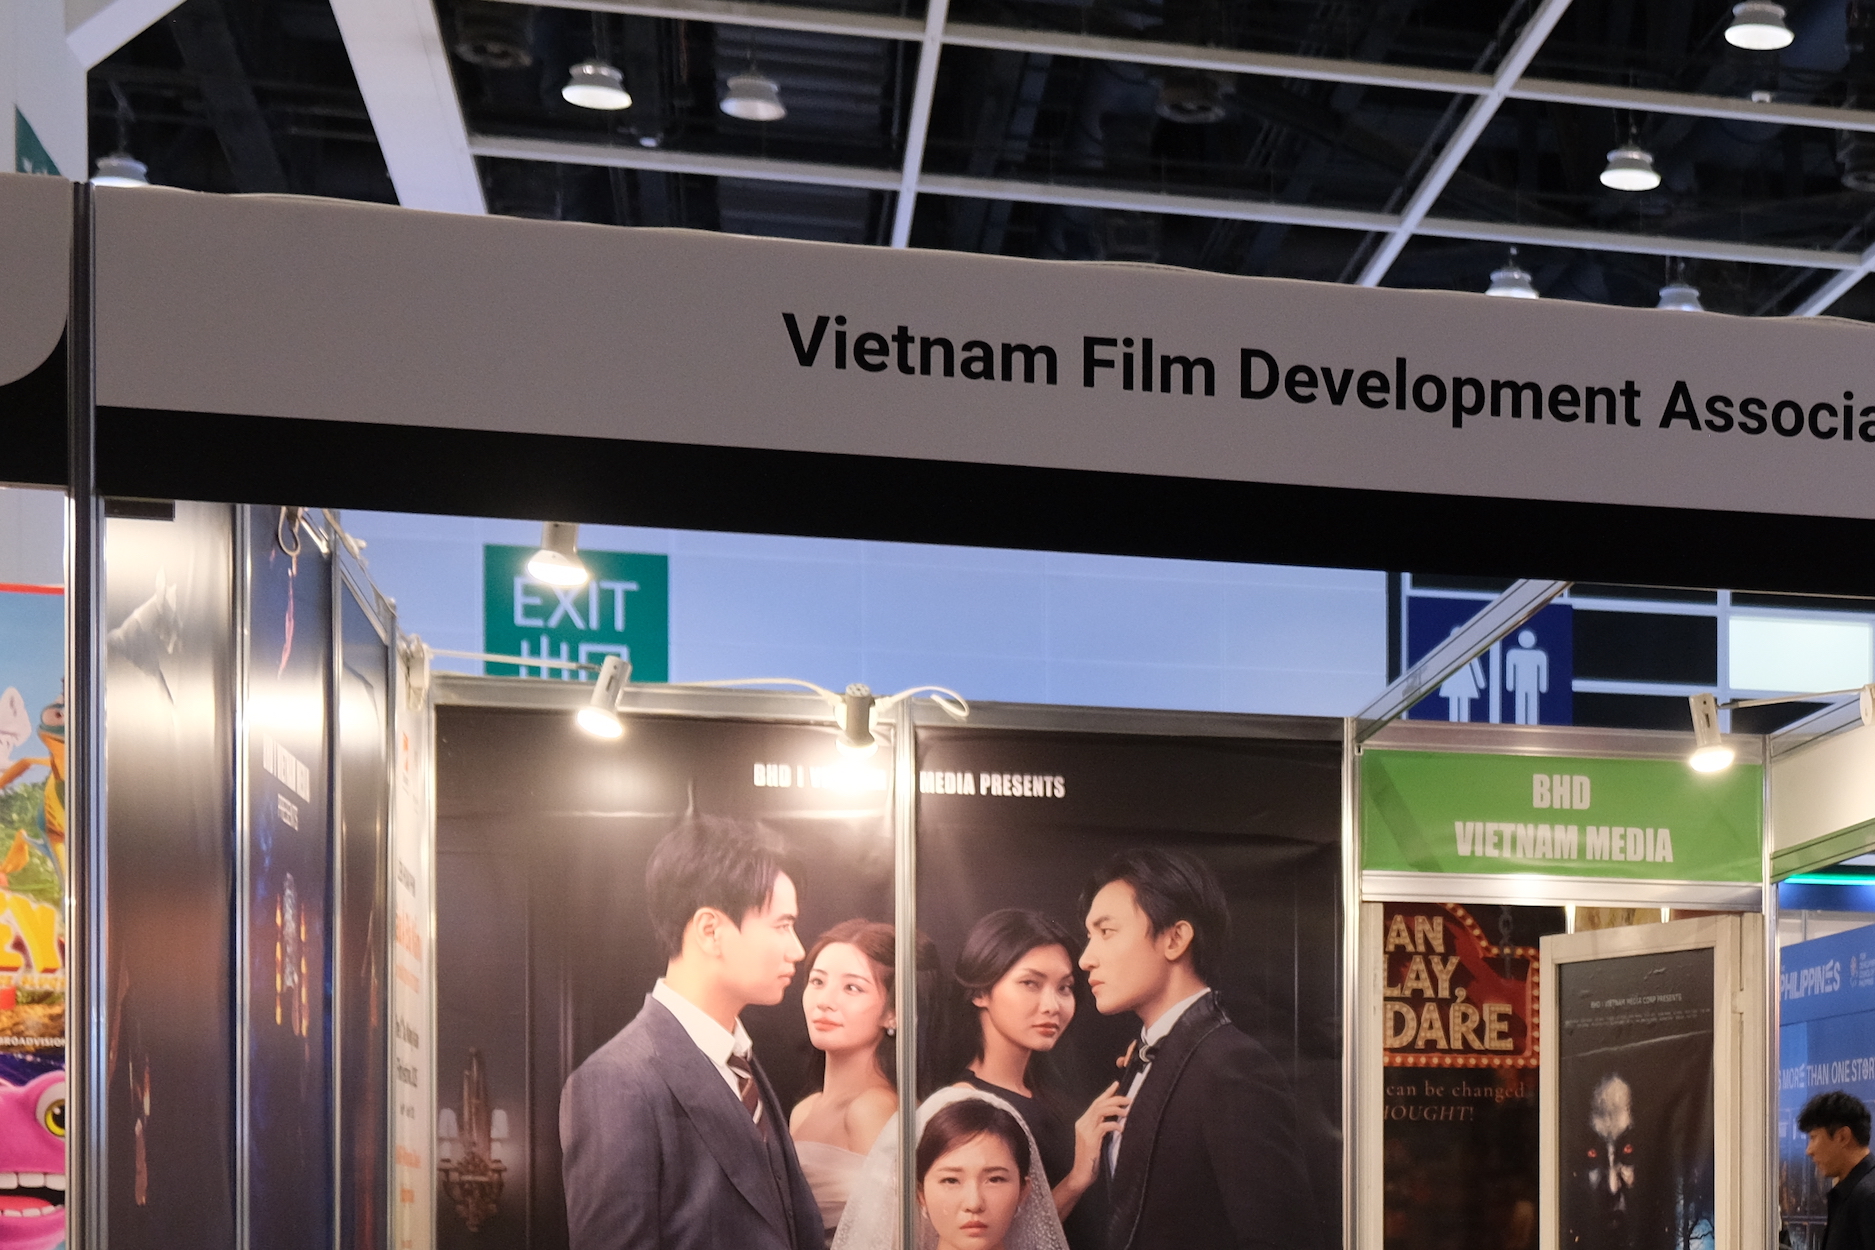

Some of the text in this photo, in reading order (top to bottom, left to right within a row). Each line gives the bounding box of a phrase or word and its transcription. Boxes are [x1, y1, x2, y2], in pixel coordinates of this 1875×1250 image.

[782, 311, 1058, 387] Vietnam
[1083, 335, 1216, 397] Film
[1240, 348, 1641, 428] Development
[513, 576, 640, 632] EXIT
[753, 763, 792, 788] BHD
[919, 771, 976, 796] MEDIA
[979, 773, 1066, 798] PRESENTS
[1532, 774, 1591, 809] BHD
[1455, 821, 1674, 862] VIETNAM MEDIA
[1385, 915, 1445, 953] AN
[1780, 959, 1841, 999] PHILIPPINES
[1384, 1001, 1514, 1050] DARE
[1386, 1080, 1525, 1103] can be changed
[1806, 1063, 1829, 1086] THAN
[1831, 1060, 1850, 1084] ONE
